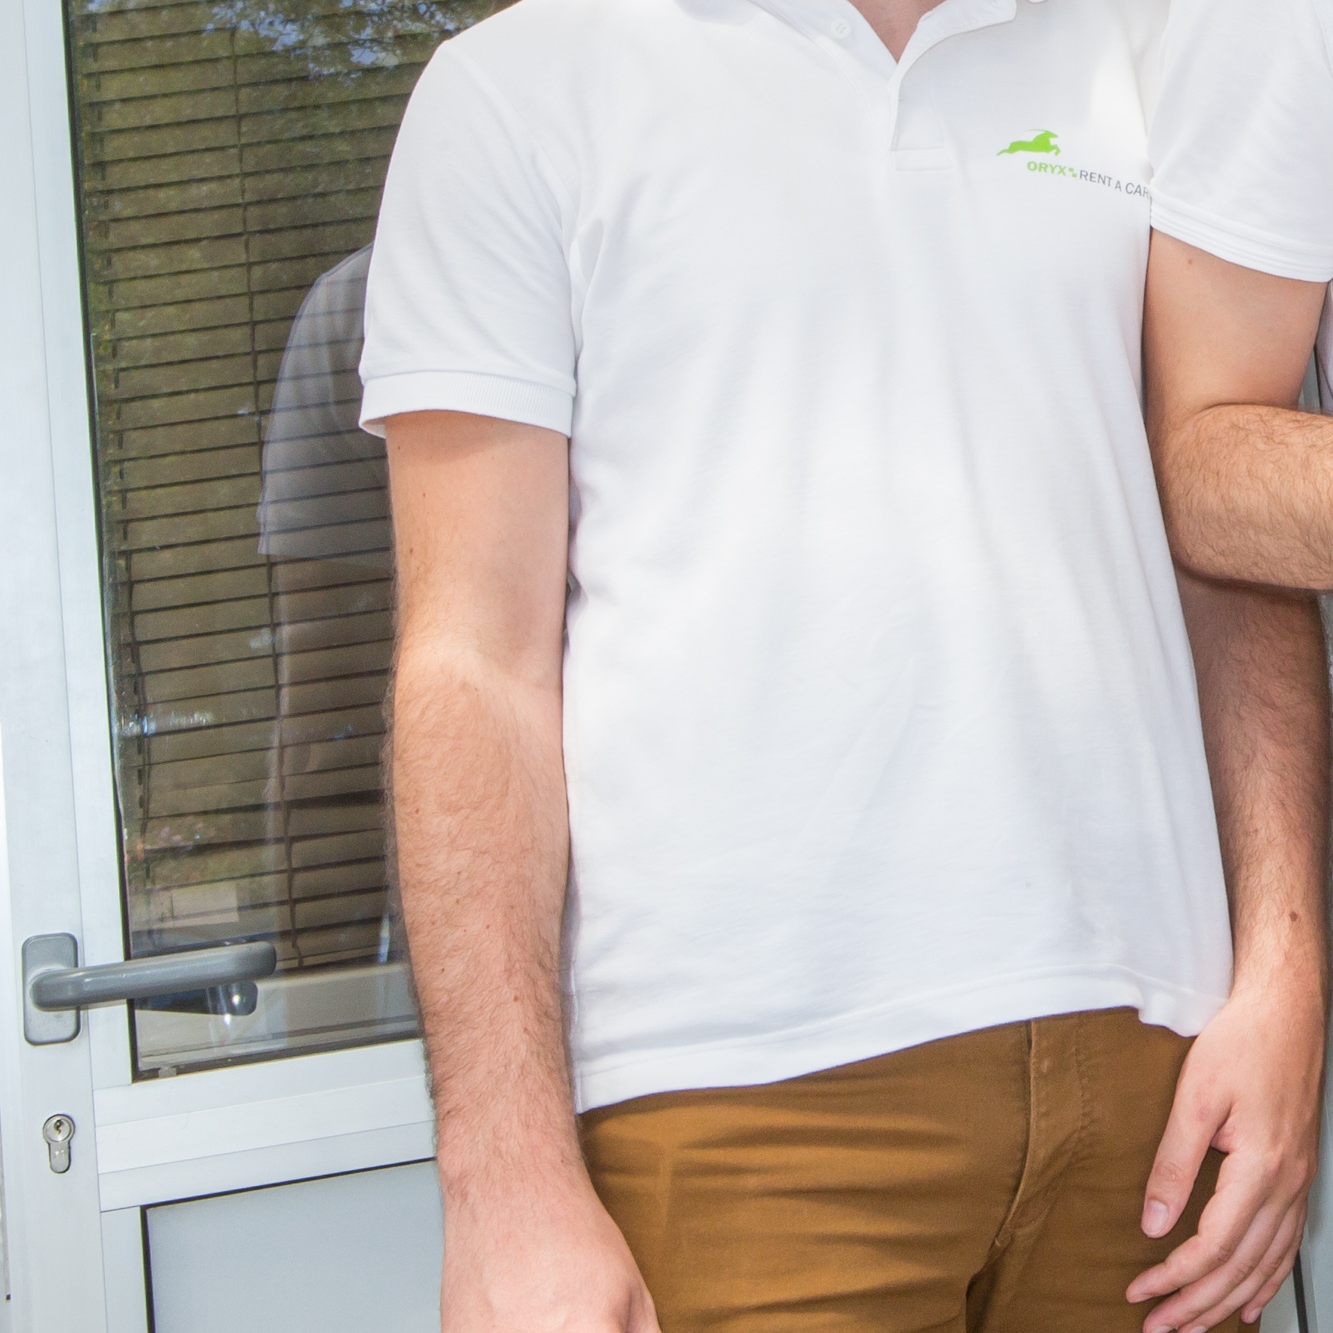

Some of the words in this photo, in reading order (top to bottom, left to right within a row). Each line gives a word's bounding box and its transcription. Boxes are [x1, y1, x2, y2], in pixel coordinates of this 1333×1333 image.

[1027, 161, 1067, 176] ORYX
[1079, 169, 1112, 187] RENT
[1114, 180, 1122, 192] A
[1125, 182, 1149, 199] CAR
